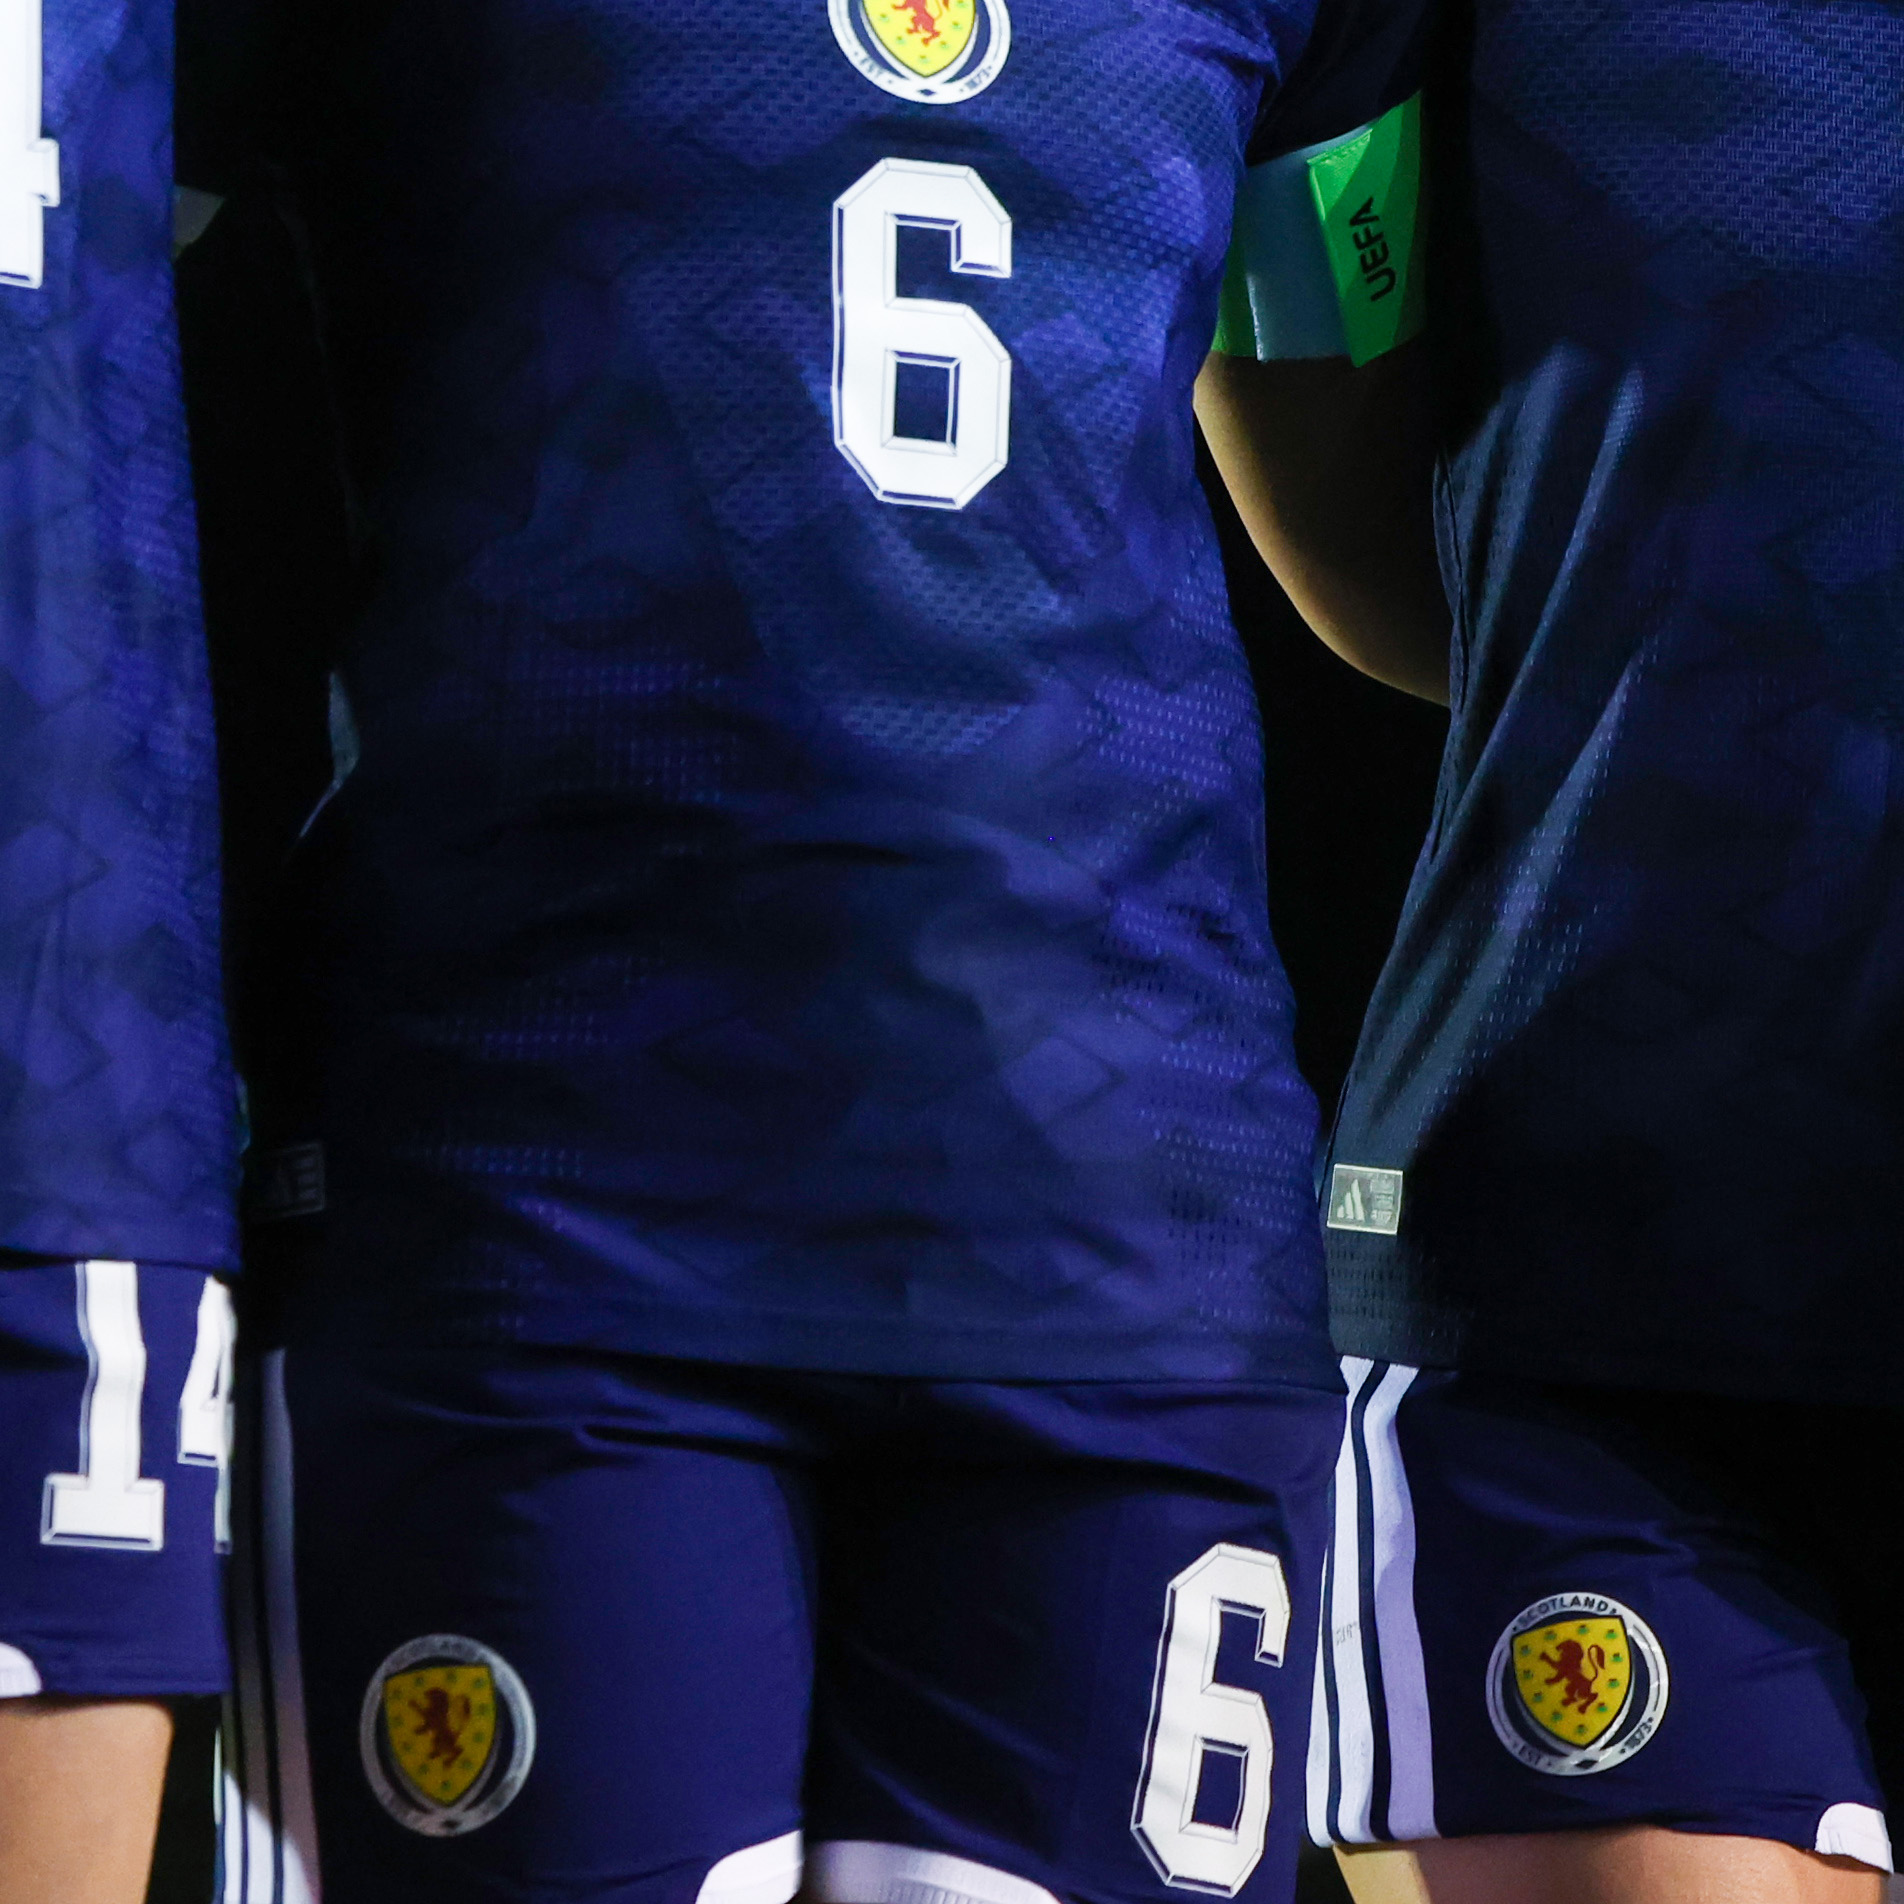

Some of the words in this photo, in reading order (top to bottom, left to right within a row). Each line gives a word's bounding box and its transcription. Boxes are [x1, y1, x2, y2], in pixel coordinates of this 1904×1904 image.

[828, 156, 1014, 512] 6
[1348, 196, 1397, 302] UEFA
[1128, 1540, 1292, 1900] 6
